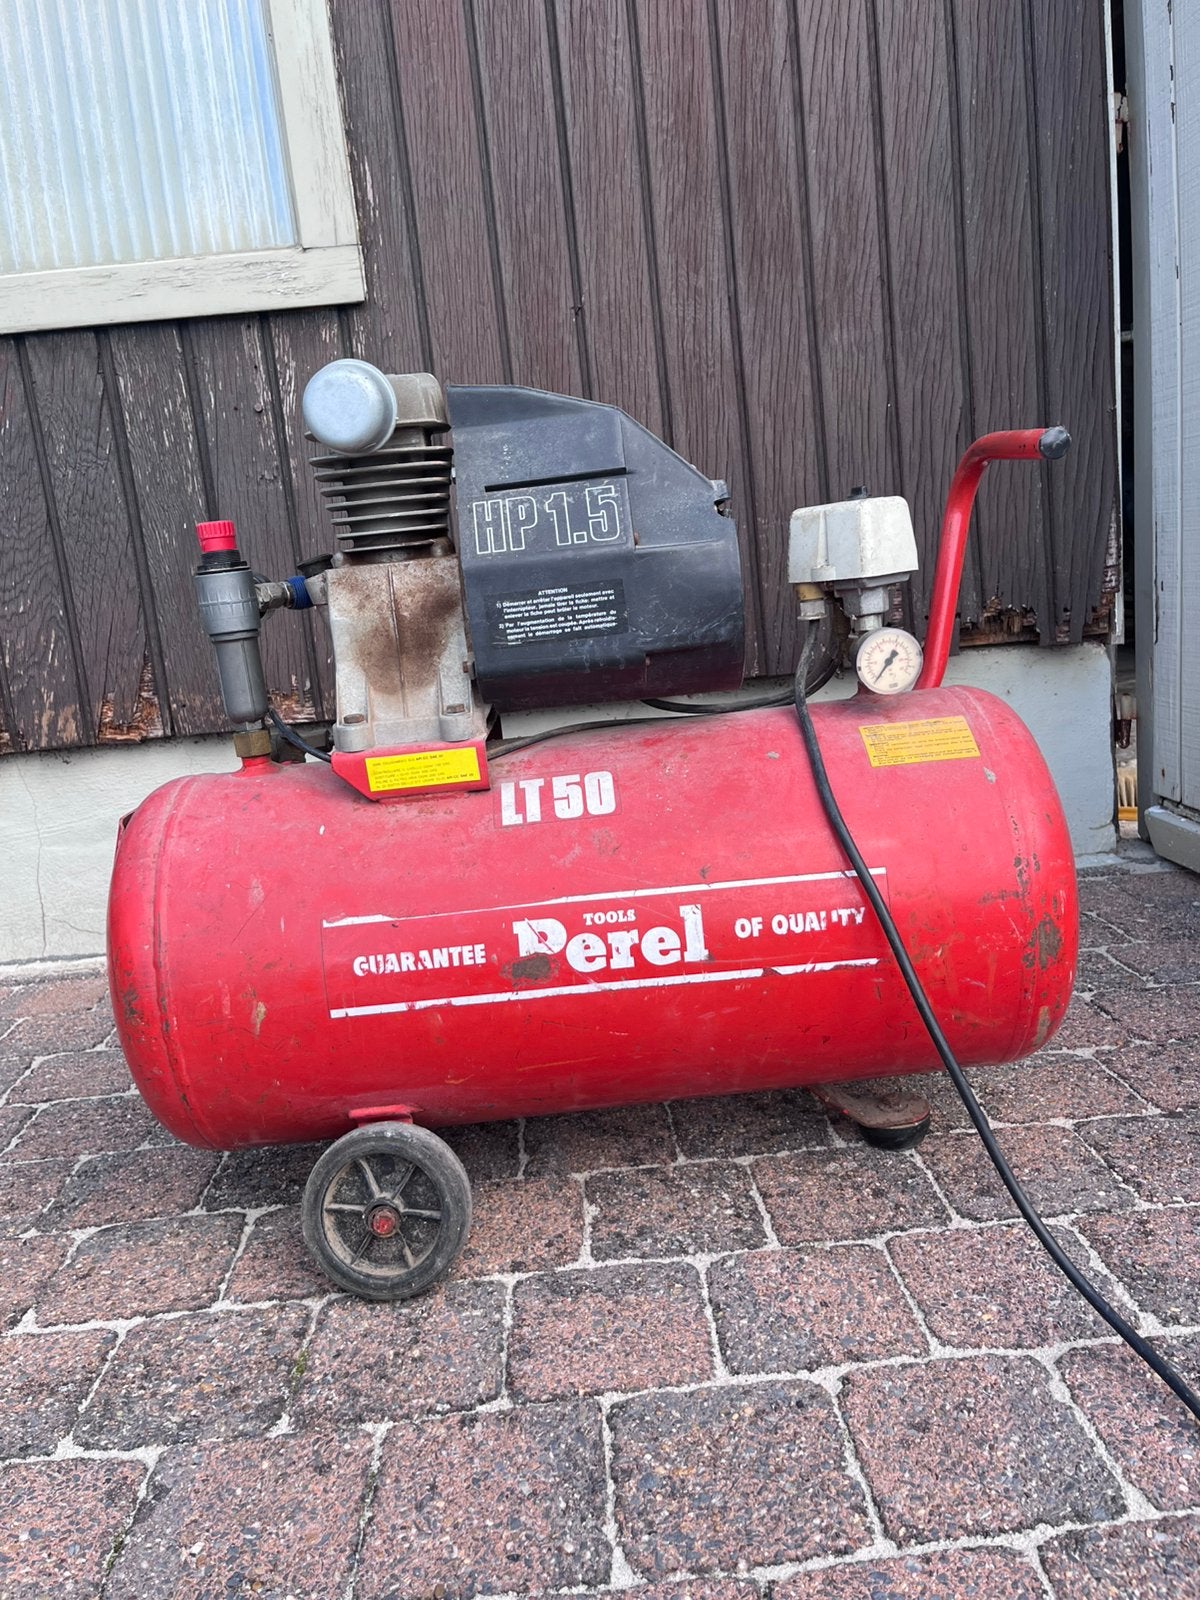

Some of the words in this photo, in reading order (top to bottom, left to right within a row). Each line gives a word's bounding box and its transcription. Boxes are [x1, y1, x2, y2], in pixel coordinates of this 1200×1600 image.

[472, 495, 538, 555] HP
[545, 484, 620, 547] 1.5
[502, 600, 526, 608] Démarrer
[575, 590, 601, 599] seulement
[538, 587, 568, 596] ATTENTION
[500, 778, 545, 826] LT
[552, 770, 616, 819] 50
[583, 909, 636, 926] TOOLS
[734, 916, 763, 939] OF
[512, 904, 709, 974] Perel
[353, 943, 487, 977] GUARANTEE
